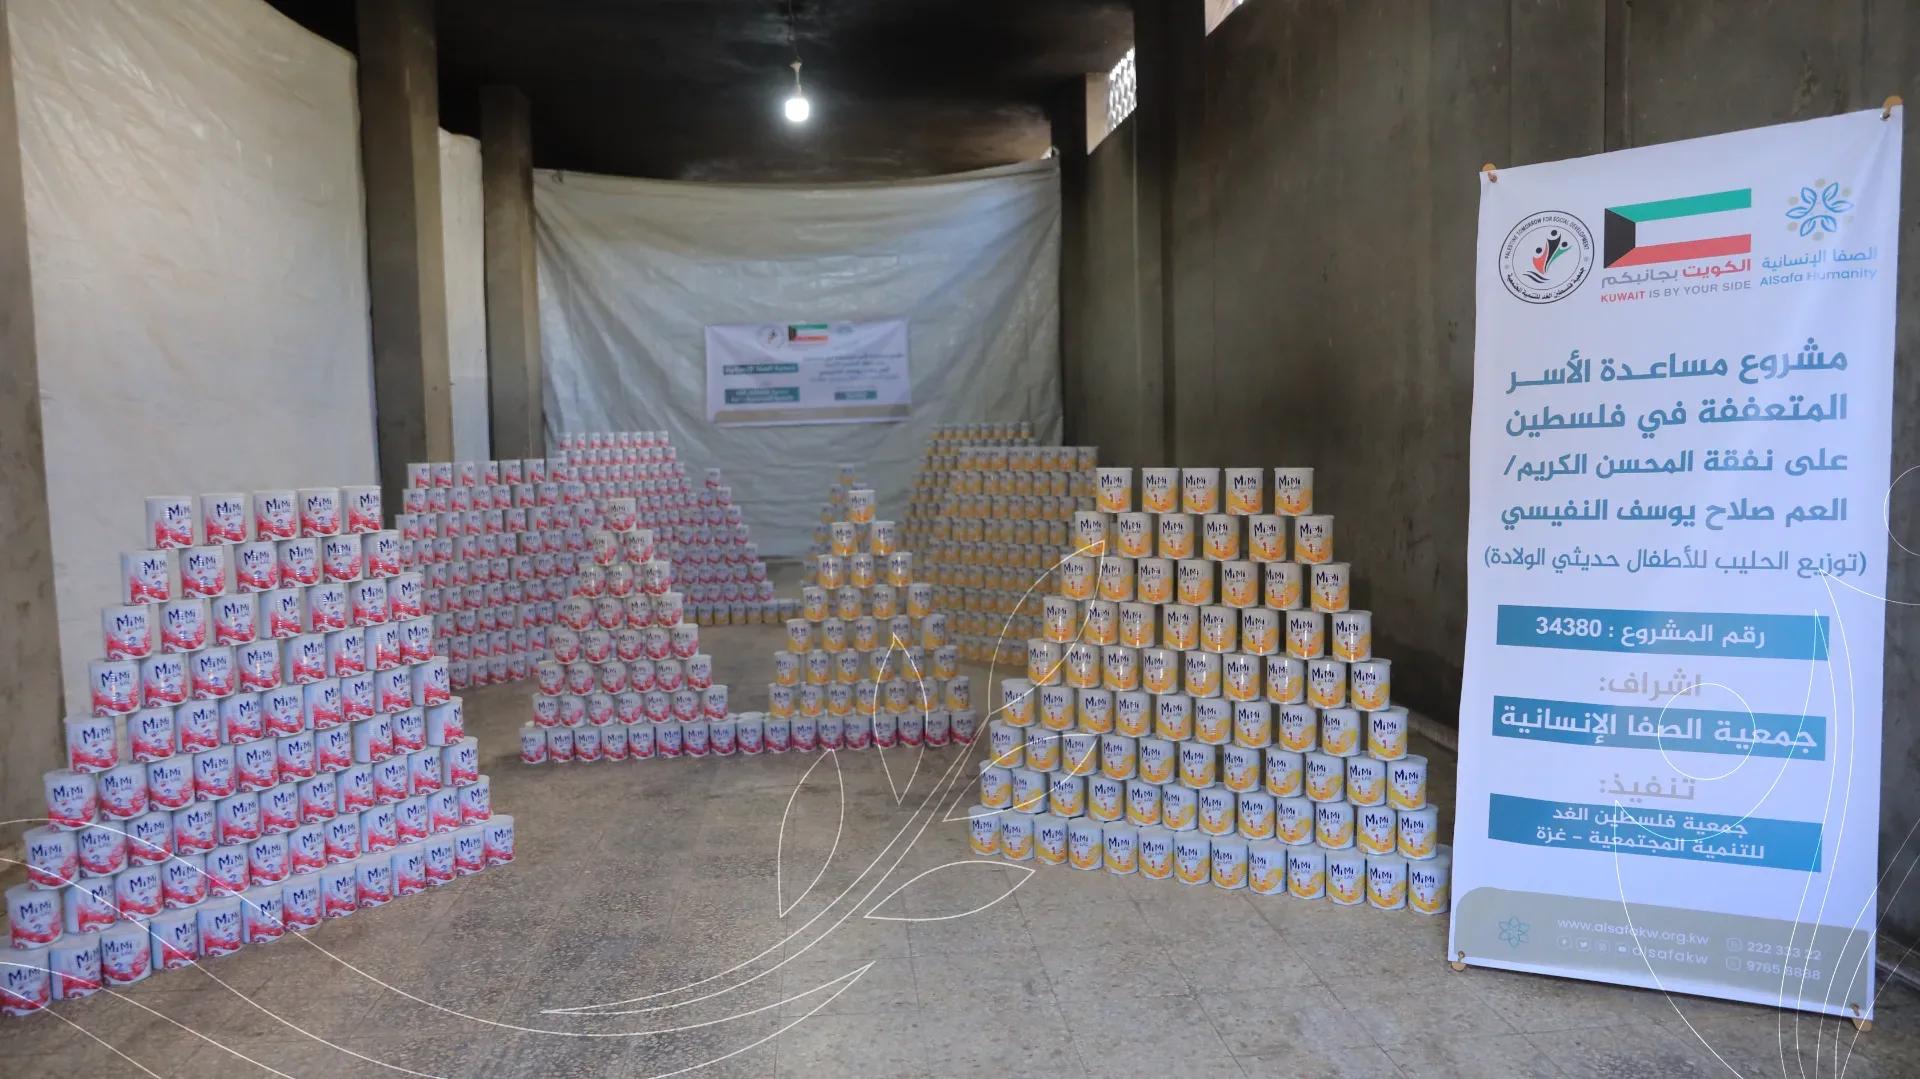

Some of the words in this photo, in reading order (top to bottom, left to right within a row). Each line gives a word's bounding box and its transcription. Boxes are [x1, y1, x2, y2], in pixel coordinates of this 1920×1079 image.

[1504, 235, 1518, 258] PALESTINE
[1516, 218, 1542, 236] TOMORROW
[1553, 216, 1570, 225] SOCIAL
[1570, 221, 1590, 250] DEVELOPMENT
[1762, 249, 1826, 272] الإنسانية
[1833, 246, 1877, 262] الصفا
[1601, 268, 1678, 288] بجانبكم
[1682, 258, 1752, 278] الكويت
[1760, 273, 1803, 286] AlSafa
[1806, 268, 1877, 280] Humanity
[1601, 290, 1646, 302] KUWAIT
[1649, 290, 1660, 298] IS
[1664, 288, 1680, 298] BY
[1683, 284, 1718, 295] YOUR
[1722, 280, 1752, 291] SIDE
[1505, 349, 1591, 395] الأسر
[1600, 352, 1728, 382] مساعدة
[1738, 337, 1848, 384] مشروع
[1506, 404, 1626, 438] فلسطين
[1637, 400, 1688, 440] في
[1698, 393, 1848, 424] المتعففة
[1596, 450, 1694, 479] المحسن
[1703, 449, 1774, 472] نفقة
[1784, 448, 1848, 477] على
[1500, 498, 1608, 531] النفيسي
[1616, 499, 1696, 528] يوسف
[1704, 498, 1776, 530] صلاح
[1785, 498, 1848, 528] العم
[1552, 546, 1620, 574] حديثي
[1626, 544, 1707, 573] للأطفال
[1714, 550, 1789, 574] الحليب
[1536, 616, 1602, 637] 34380
[1620, 618, 1713, 646] المشروع
[1722, 624, 1765, 649] رقم
[1500, 704, 1616, 744] الإنسانية
[1628, 714, 1702, 740] الصفا
[1714, 719, 1817, 754] جمعية
[1552, 806, 1589, 821] الغد
[1594, 810, 1676, 829] فلسطين
[1683, 816, 1748, 836] جمعية
[1536, 826, 1567, 842] غزة
[1588, 831, 1684, 852] المجتمعية
[1692, 838, 1764, 860] للتنمية
[1558, 918, 1710, 946] www.alsafakw.org.kw
[1632, 946, 1708, 965] alsafakw
[1747, 942, 1772, 954] 222
[1746, 960, 1781, 974] 9765
